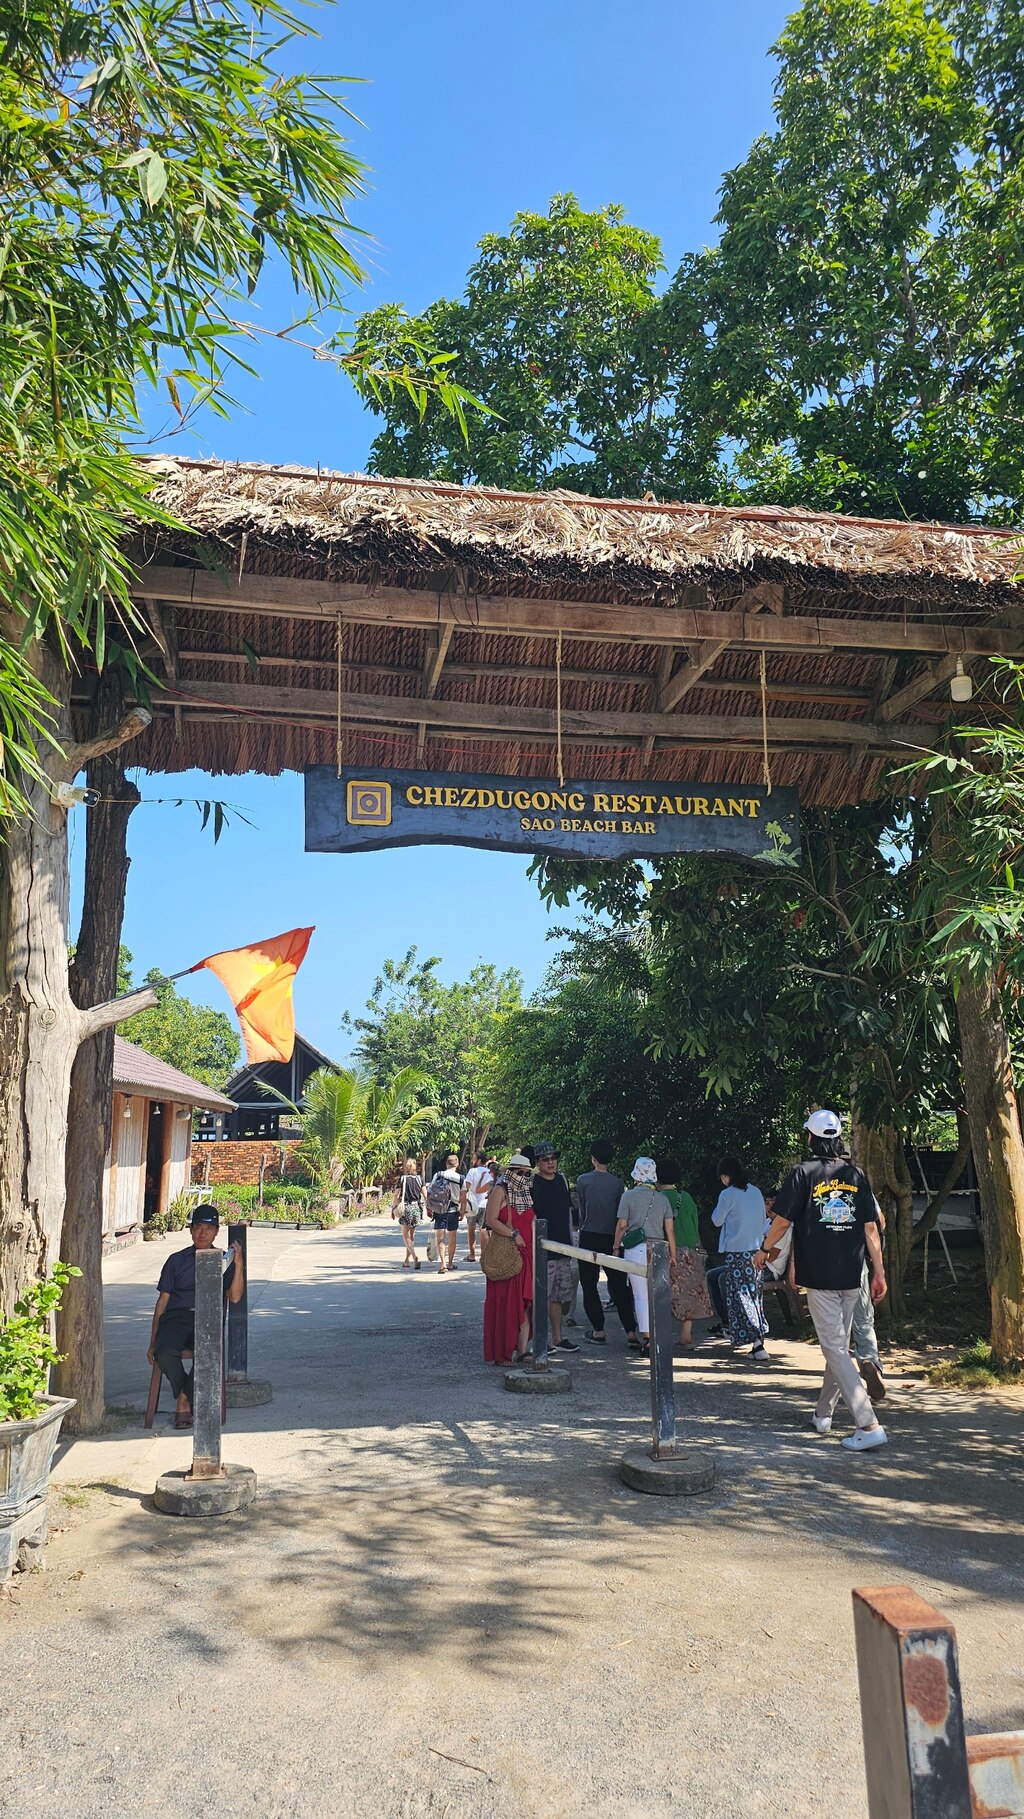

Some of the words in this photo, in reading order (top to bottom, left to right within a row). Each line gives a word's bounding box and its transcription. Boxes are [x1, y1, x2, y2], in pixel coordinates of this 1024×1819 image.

[406, 785, 586, 812] CHEZDUGONG
[593, 793, 761, 818] RESTAURANT
[520, 817, 555, 831] SAO
[560, 819, 617, 833] BEACH
[621, 820, 657, 835] BAR
